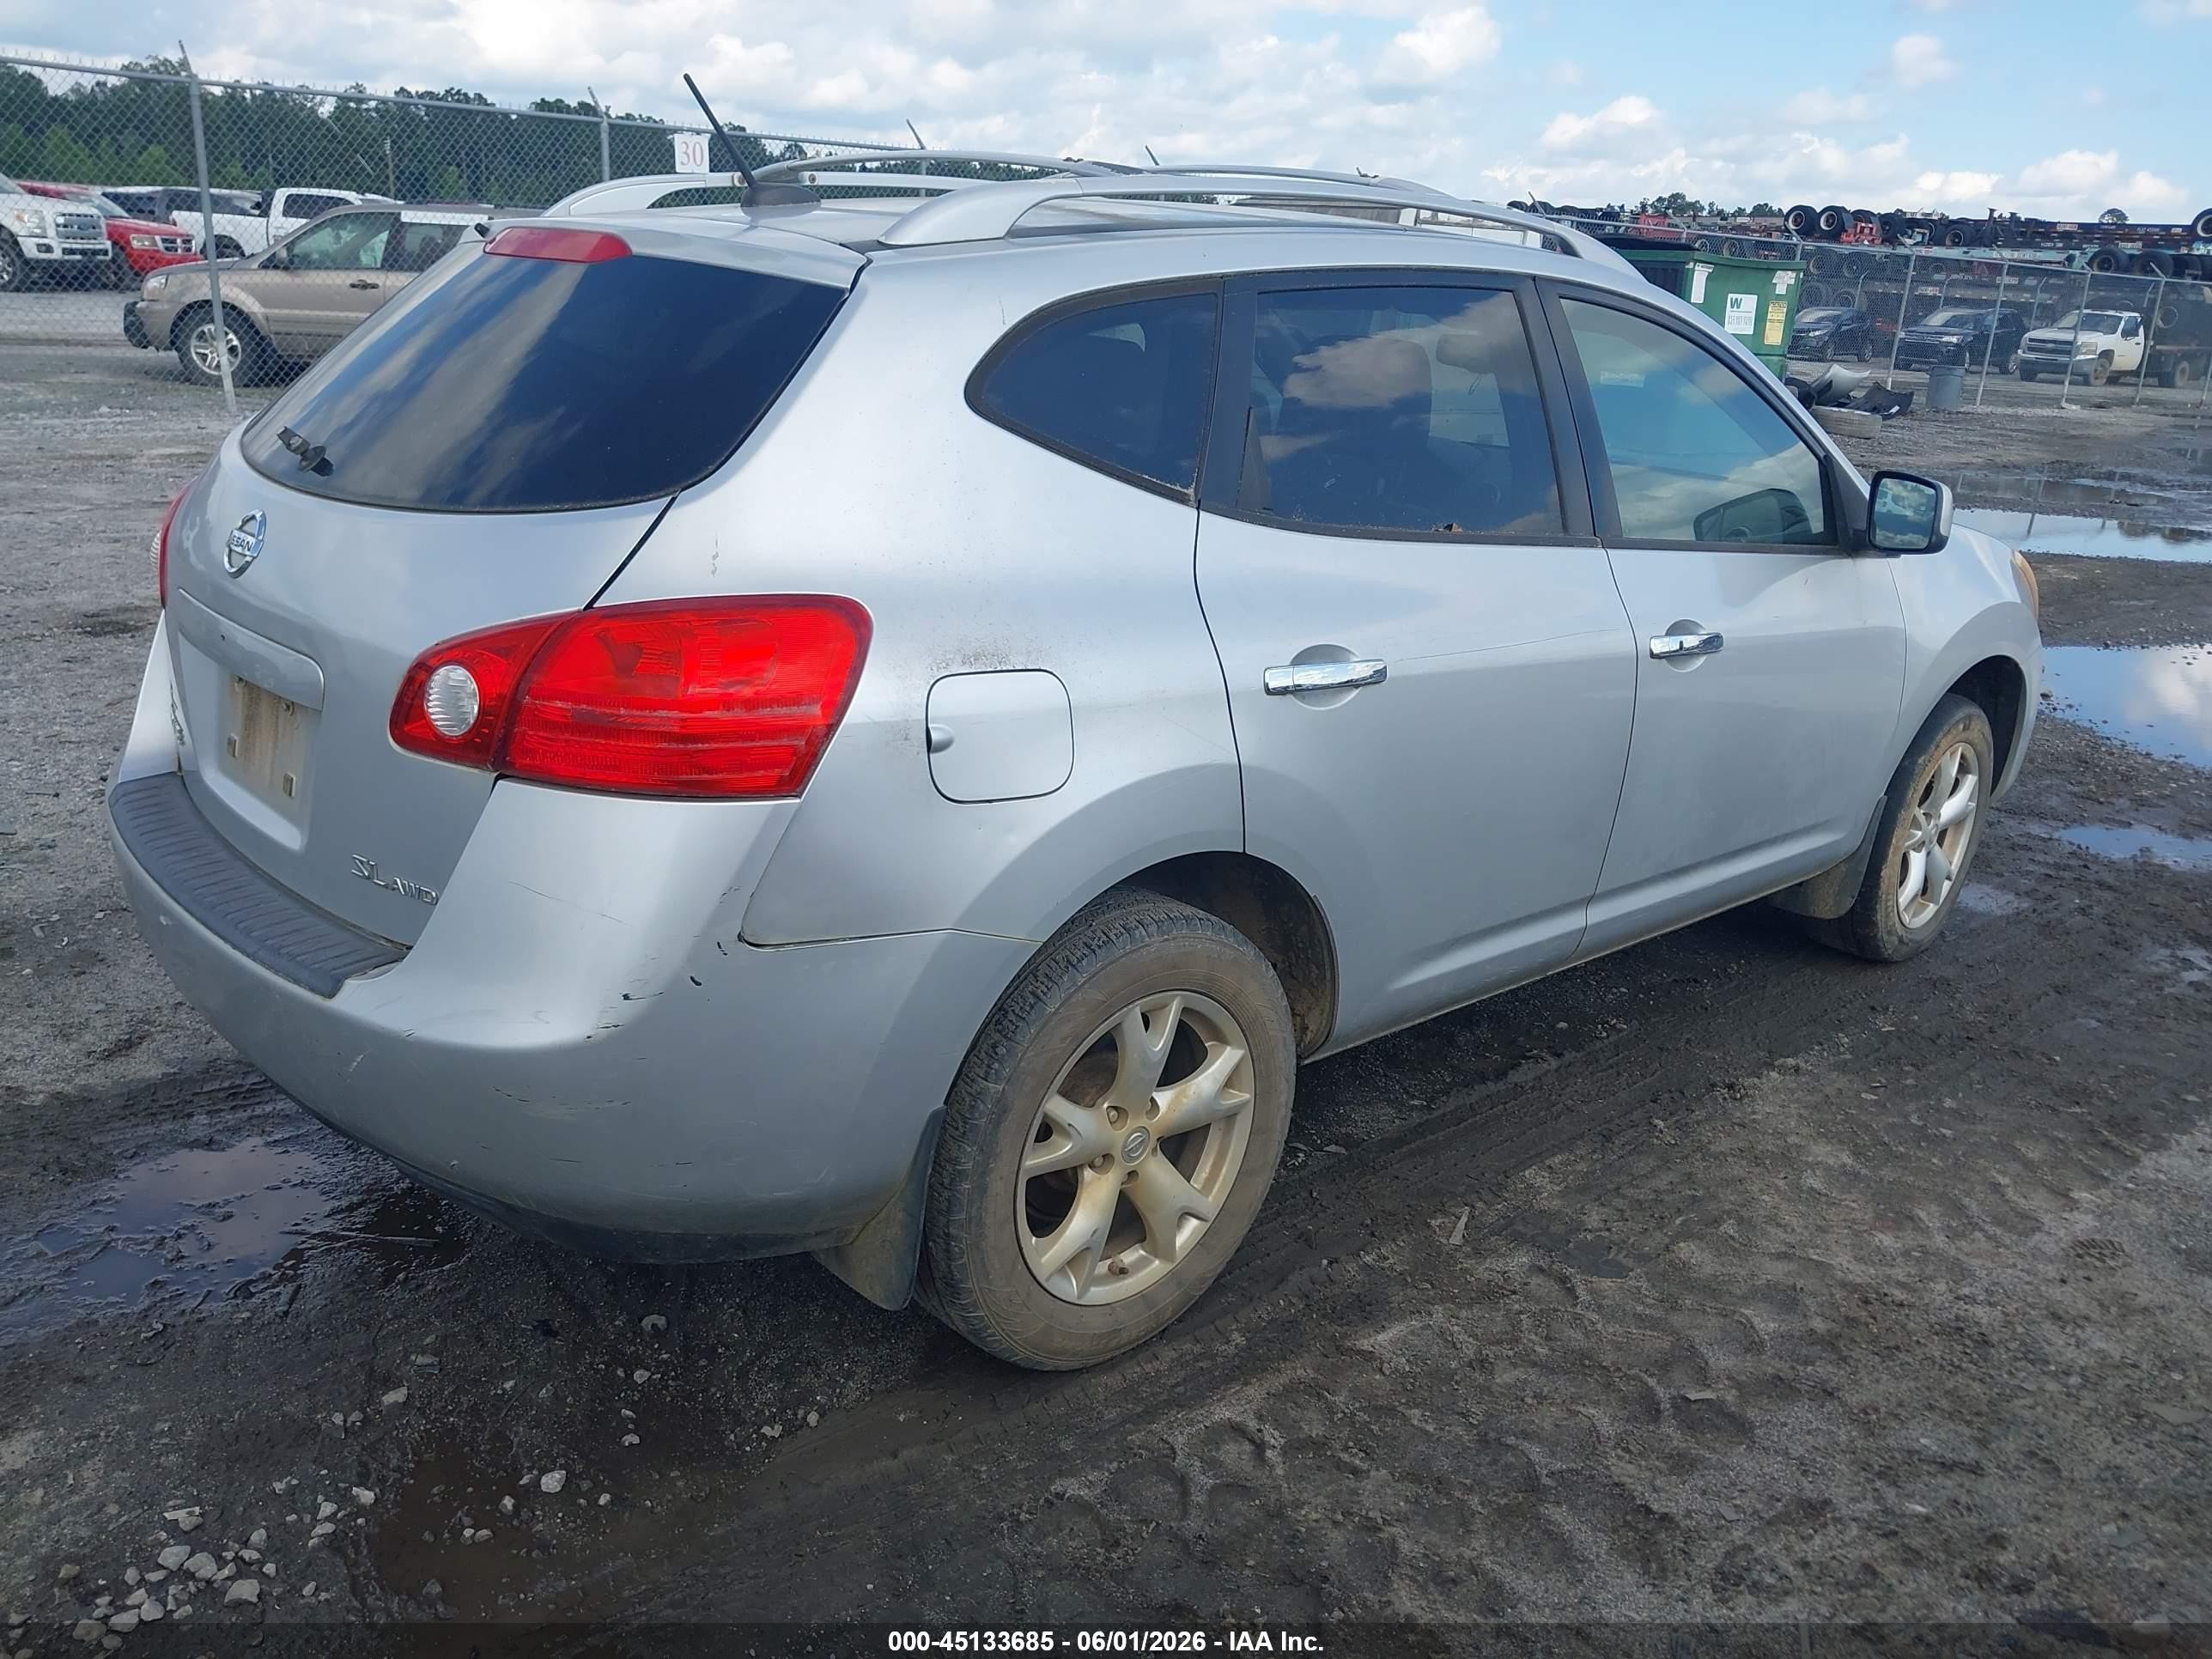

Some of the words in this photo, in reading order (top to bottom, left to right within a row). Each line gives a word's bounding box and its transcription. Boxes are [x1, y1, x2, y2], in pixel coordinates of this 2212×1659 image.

[681, 141, 704, 167] 30
[351, 854, 386, 886] SL
[392, 876, 440, 906] AWD
